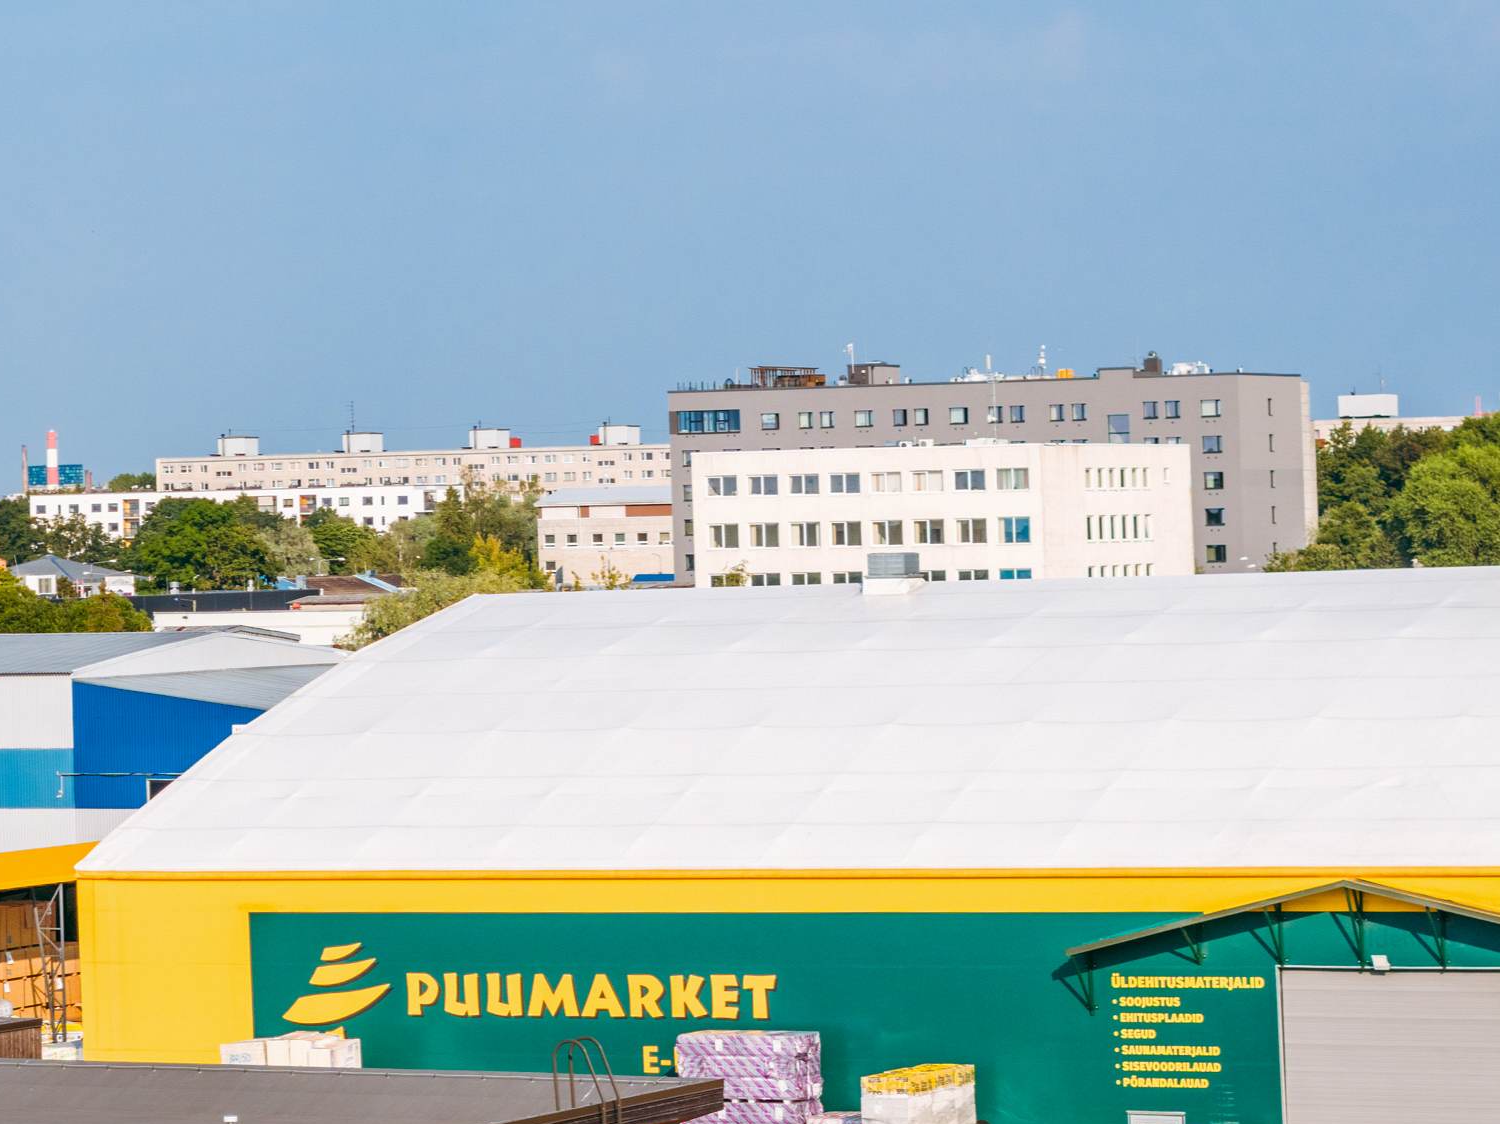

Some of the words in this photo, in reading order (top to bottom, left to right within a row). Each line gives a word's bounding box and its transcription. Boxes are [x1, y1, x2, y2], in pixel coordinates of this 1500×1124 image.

[1111, 973, 1265, 991] ÜLDEHITUSMATERJALID
[405, 971, 778, 1021] PUUMARKET
[1119, 997, 1181, 1008] SOOJUSTUS
[1120, 1013, 1204, 1024] EHITUSPLAADID
[1120, 1029, 1157, 1039] SEGUD
[1121, 1045, 1221, 1057] SAUNAMATERJALID
[1122, 1061, 1222, 1073] SISEVOODRILAUAD
[1122, 1075, 1210, 1089] PÕRANDALAUAD
